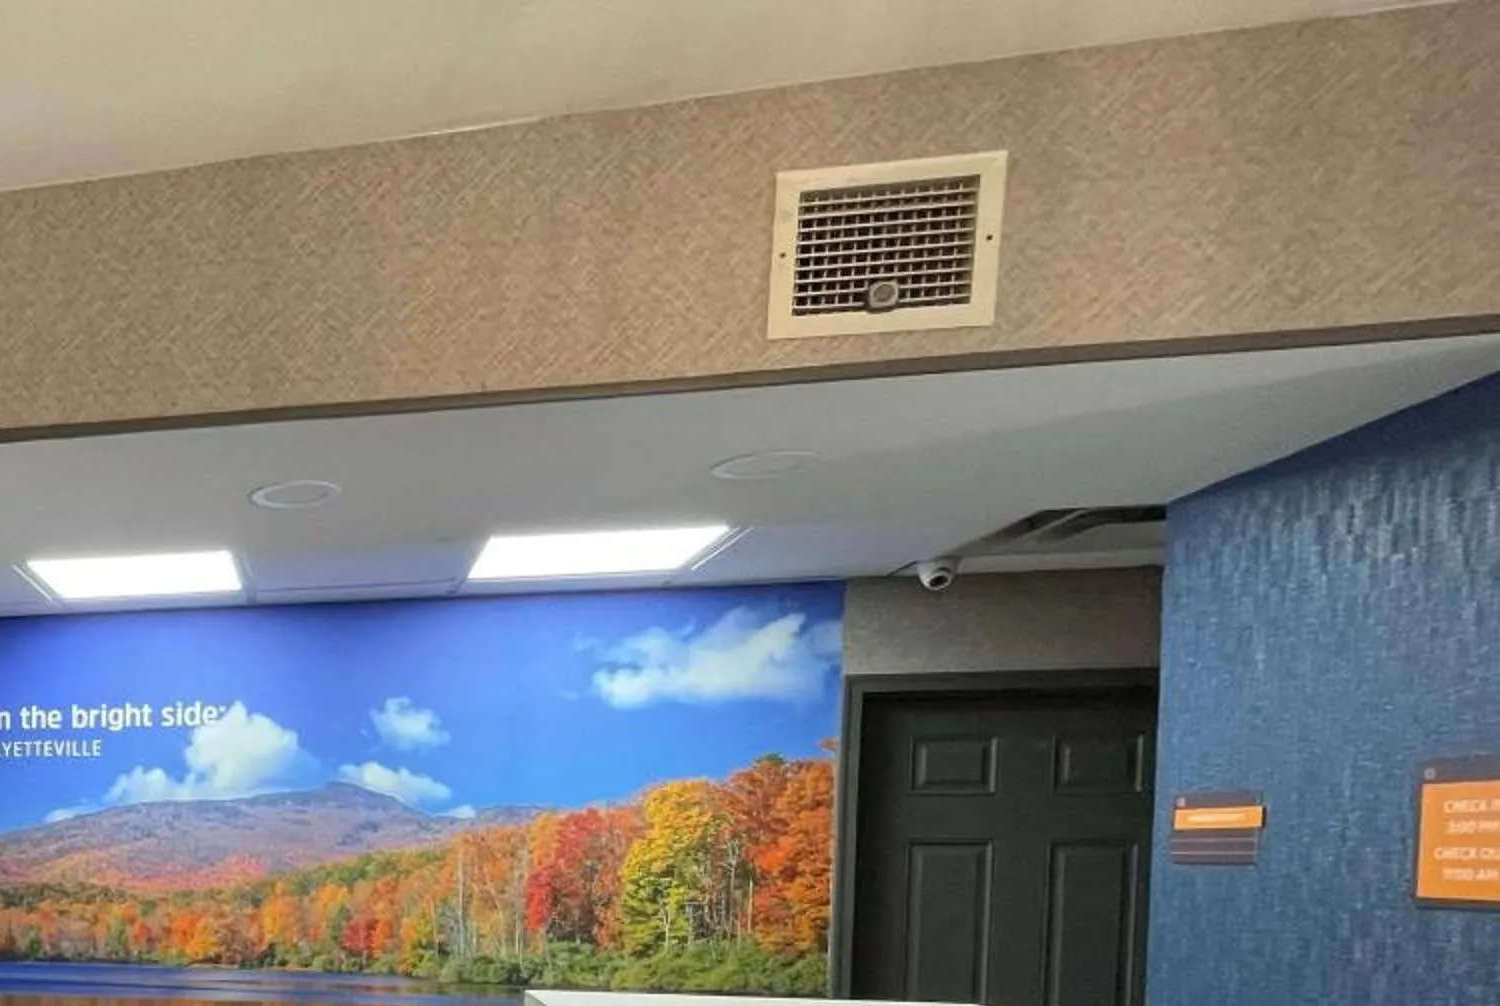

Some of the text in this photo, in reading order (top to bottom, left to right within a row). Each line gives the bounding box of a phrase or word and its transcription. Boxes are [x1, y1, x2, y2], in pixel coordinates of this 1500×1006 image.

[20, 705, 62, 729] the
[71, 702, 153, 731] bright
[1442, 799, 1488, 813] CHECK
[1433, 847, 1477, 860] CHECK
